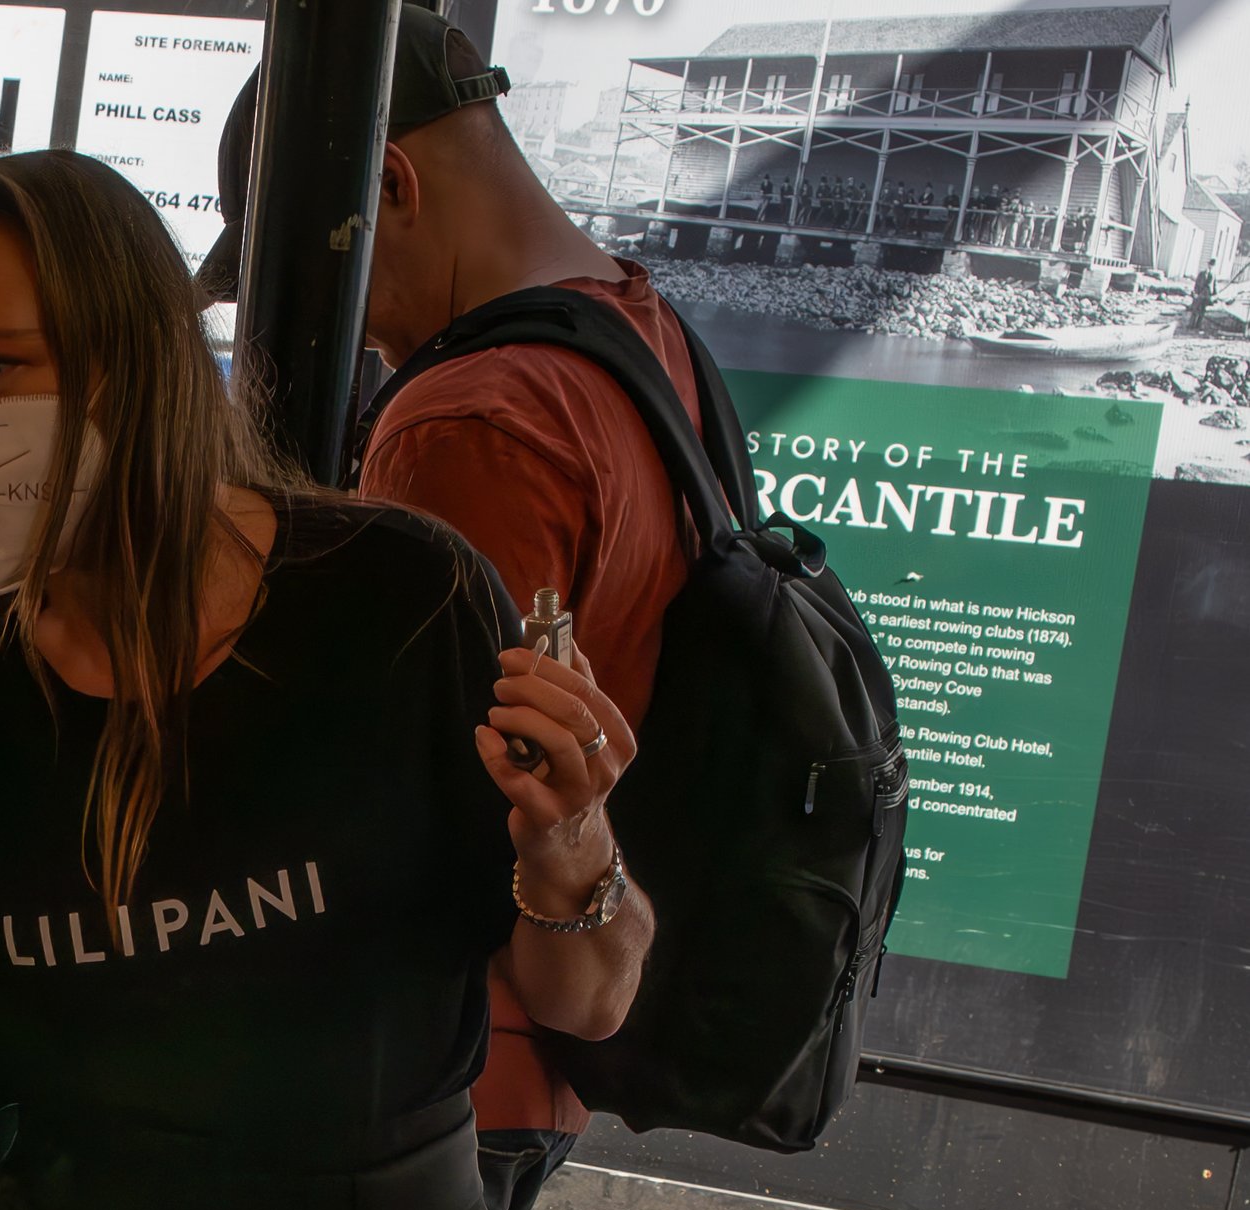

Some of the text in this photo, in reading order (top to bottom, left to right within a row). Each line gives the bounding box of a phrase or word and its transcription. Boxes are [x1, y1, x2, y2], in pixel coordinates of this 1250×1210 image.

[135, 35, 252, 55] SITE FOREMAN:
[98, 73, 134, 84] NAME:
[94, 103, 201, 124] PHILL CASS
[746, 431, 1028, 478] STORY OF THE
[870, 592, 911, 608] stood
[913, 596, 926, 610] in
[929, 598, 964, 613] what
[967, 602, 980, 616] is
[982, 605, 1014, 619] now
[1016, 606, 1076, 626] Hickson
[879, 614, 931, 631] earliest
[933, 620, 983, 639] rowing
[985, 624, 1025, 641] clubs
[1027, 629, 1073, 649] (1874).
[887, 634, 902, 648] to
[904, 637, 968, 656] compete
[970, 642, 984, 656] in
[986, 647, 1036, 665] rowing
[899, 655, 952, 677] Rowing
[954, 661, 989, 678] Club
[991, 666, 1021, 682] that
[1023, 671, 1053, 685] was
[892, 674, 983, 697] Sydney Cove
[918, 727, 972, 749] Rowing
[974, 734, 1009, 751] Club
[1011, 738, 1054, 758] Hotel,
[943, 751, 986, 769] Hotel.
[958, 782, 994, 800] 1914,
[923, 799, 1018, 823] concentrated
[925, 847, 946, 862] for
[2, 861, 326, 967] LILIPANI
